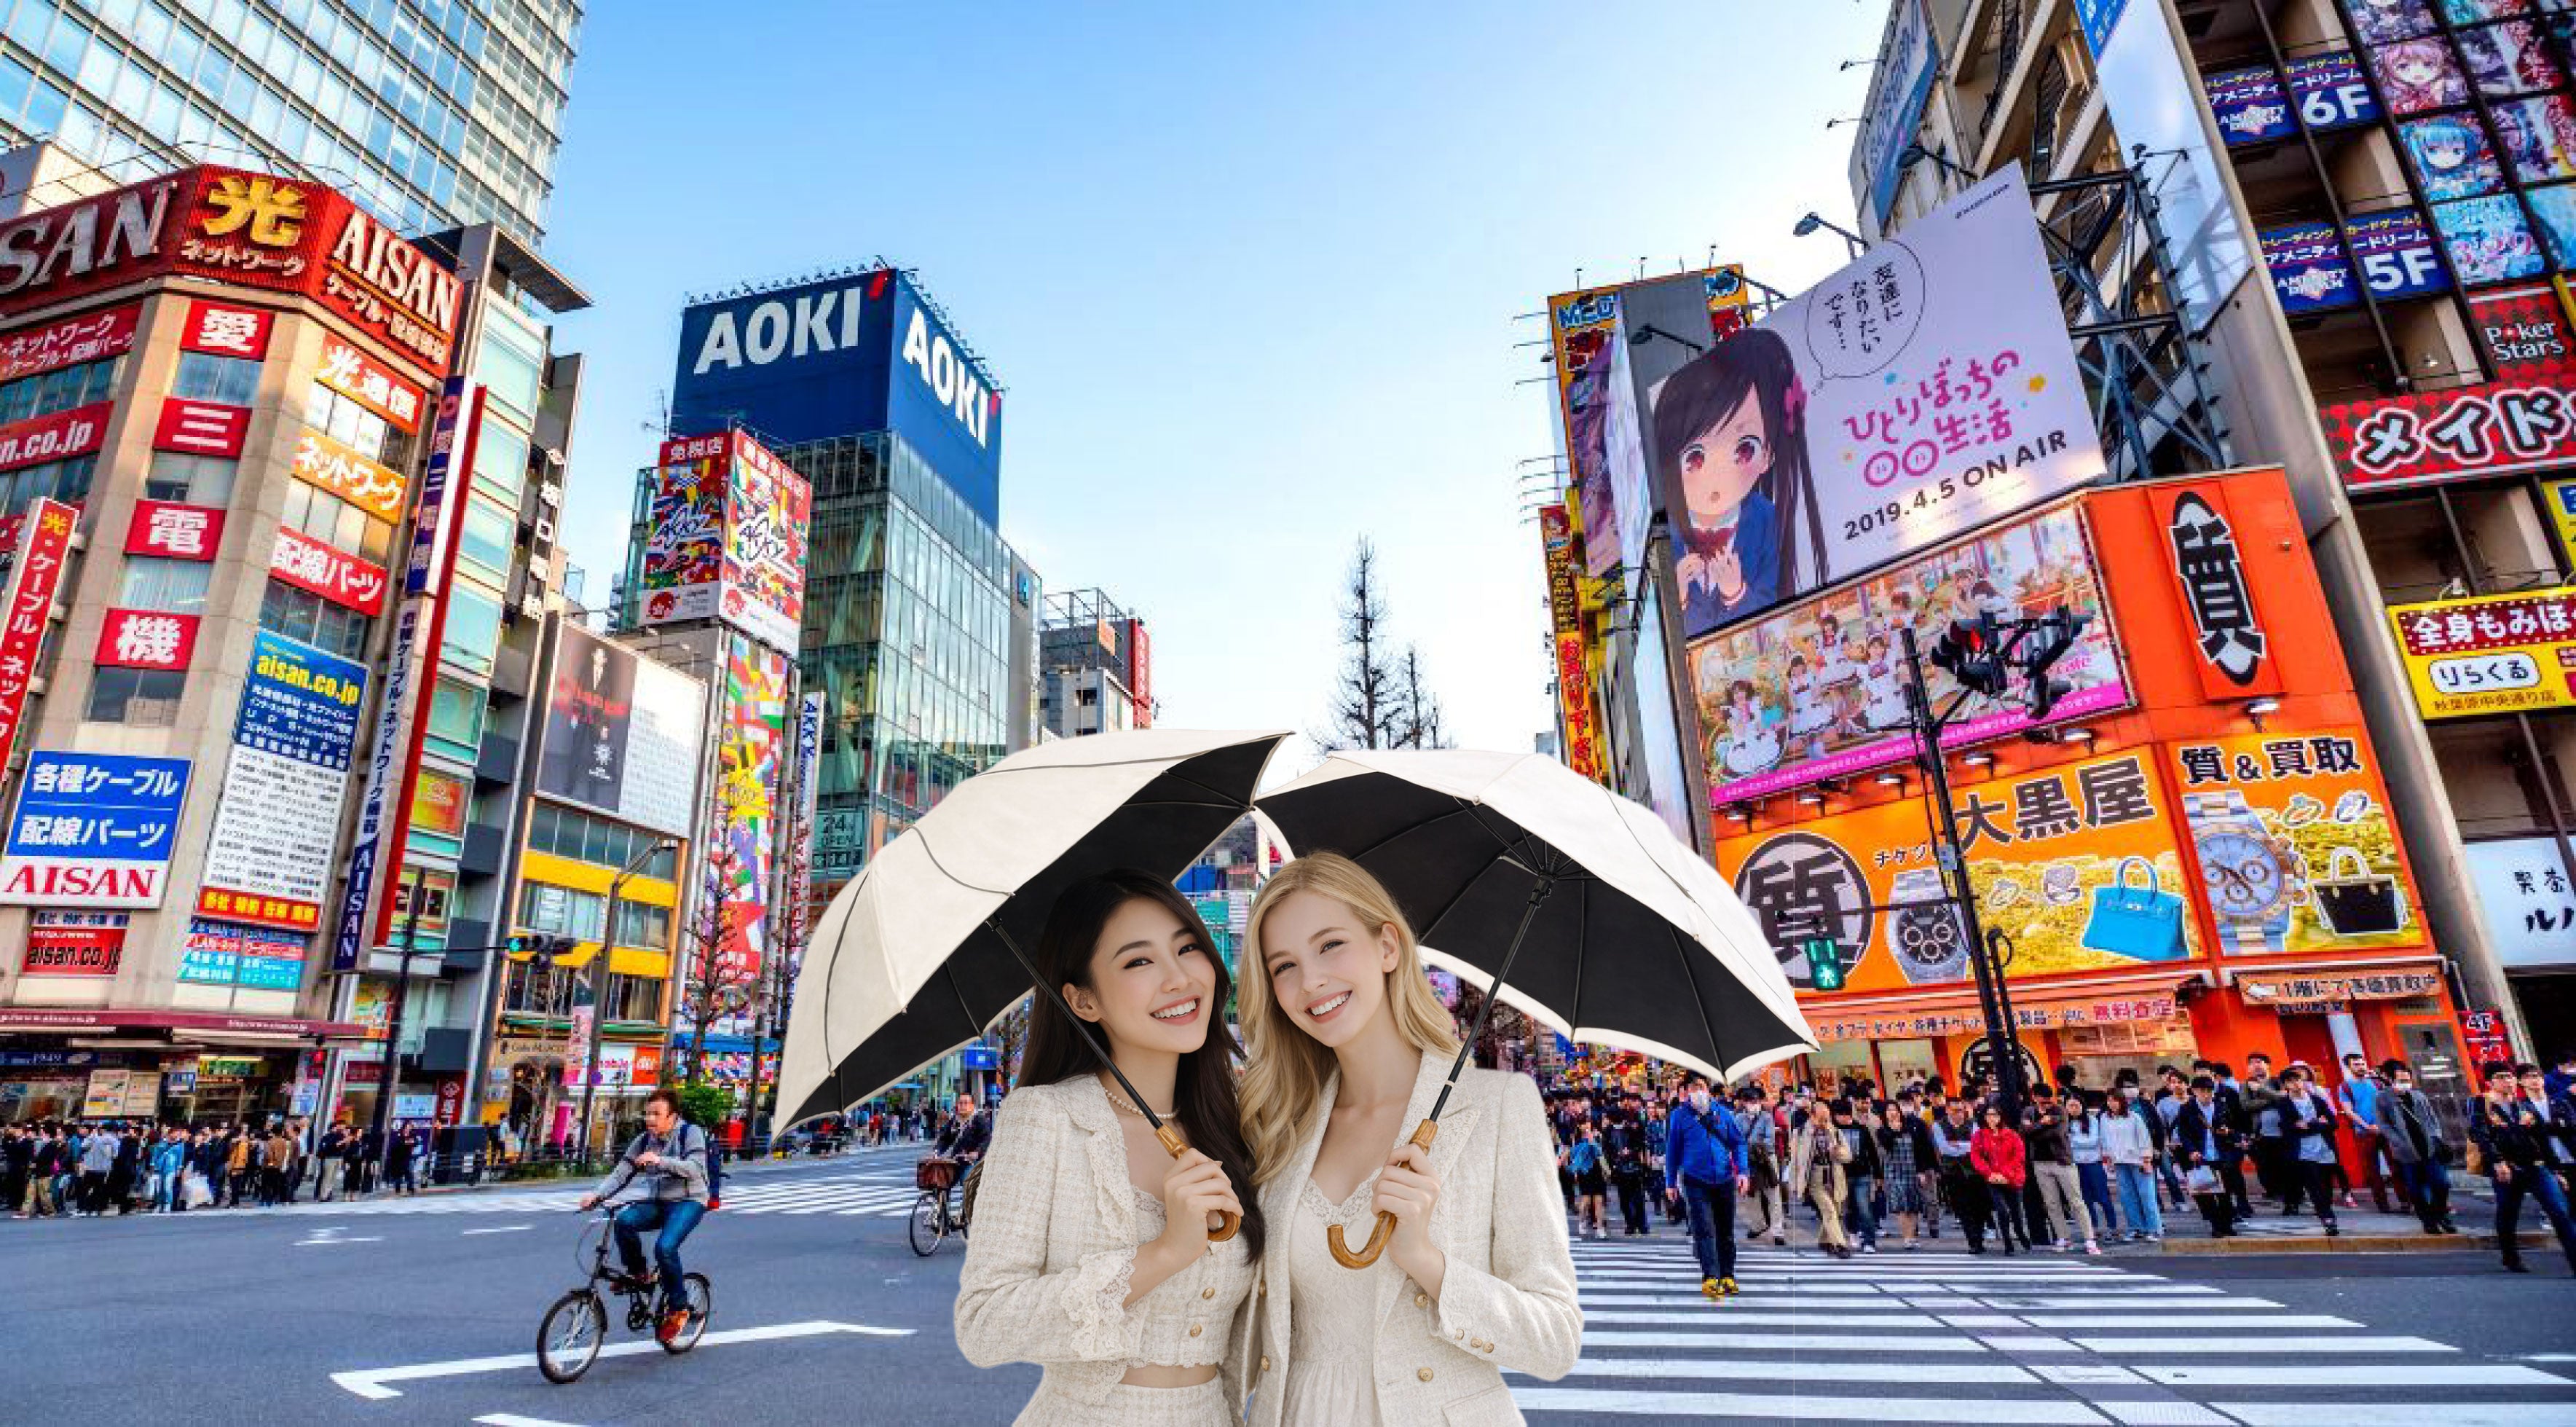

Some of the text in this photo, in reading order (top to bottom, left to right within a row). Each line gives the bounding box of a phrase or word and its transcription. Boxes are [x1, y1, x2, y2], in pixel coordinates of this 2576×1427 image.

[2302, 84, 2373, 125] 6F
[203, 176, 305, 246] 光
[181, 238, 306, 276] ネットワーク
[333, 211, 461, 331] AISAN
[2363, 248, 2438, 291] 5F
[693, 286, 861, 374] AOKI
[2494, 339, 2564, 360] Stars
[903, 307, 988, 449] AOKI
[1844, 350, 2020, 444] ひとりぼっちの
[173, 406, 234, 448] 三
[2357, 389, 2576, 472] メイド
[294, 440, 405, 510] ネットワーク
[1845, 479, 1955, 541] 2019.4.5
[1963, 455, 2007, 488] ON
[2015, 430, 2067, 468] AIR
[270, 534, 384, 603] 配線パーツ
[2413, 603, 2576, 647] 全身もみほ
[257, 656, 360, 705] aisan.co.jp
[31, 763, 178, 797] 各種ケーブル
[1952, 757, 2156, 850] 大黒屋
[17, 815, 166, 847] 配線パーツ
[1875, 842, 1934, 867] チケッ
[4, 865, 156, 897] AISAN
[339, 849, 372, 957] AISAN
